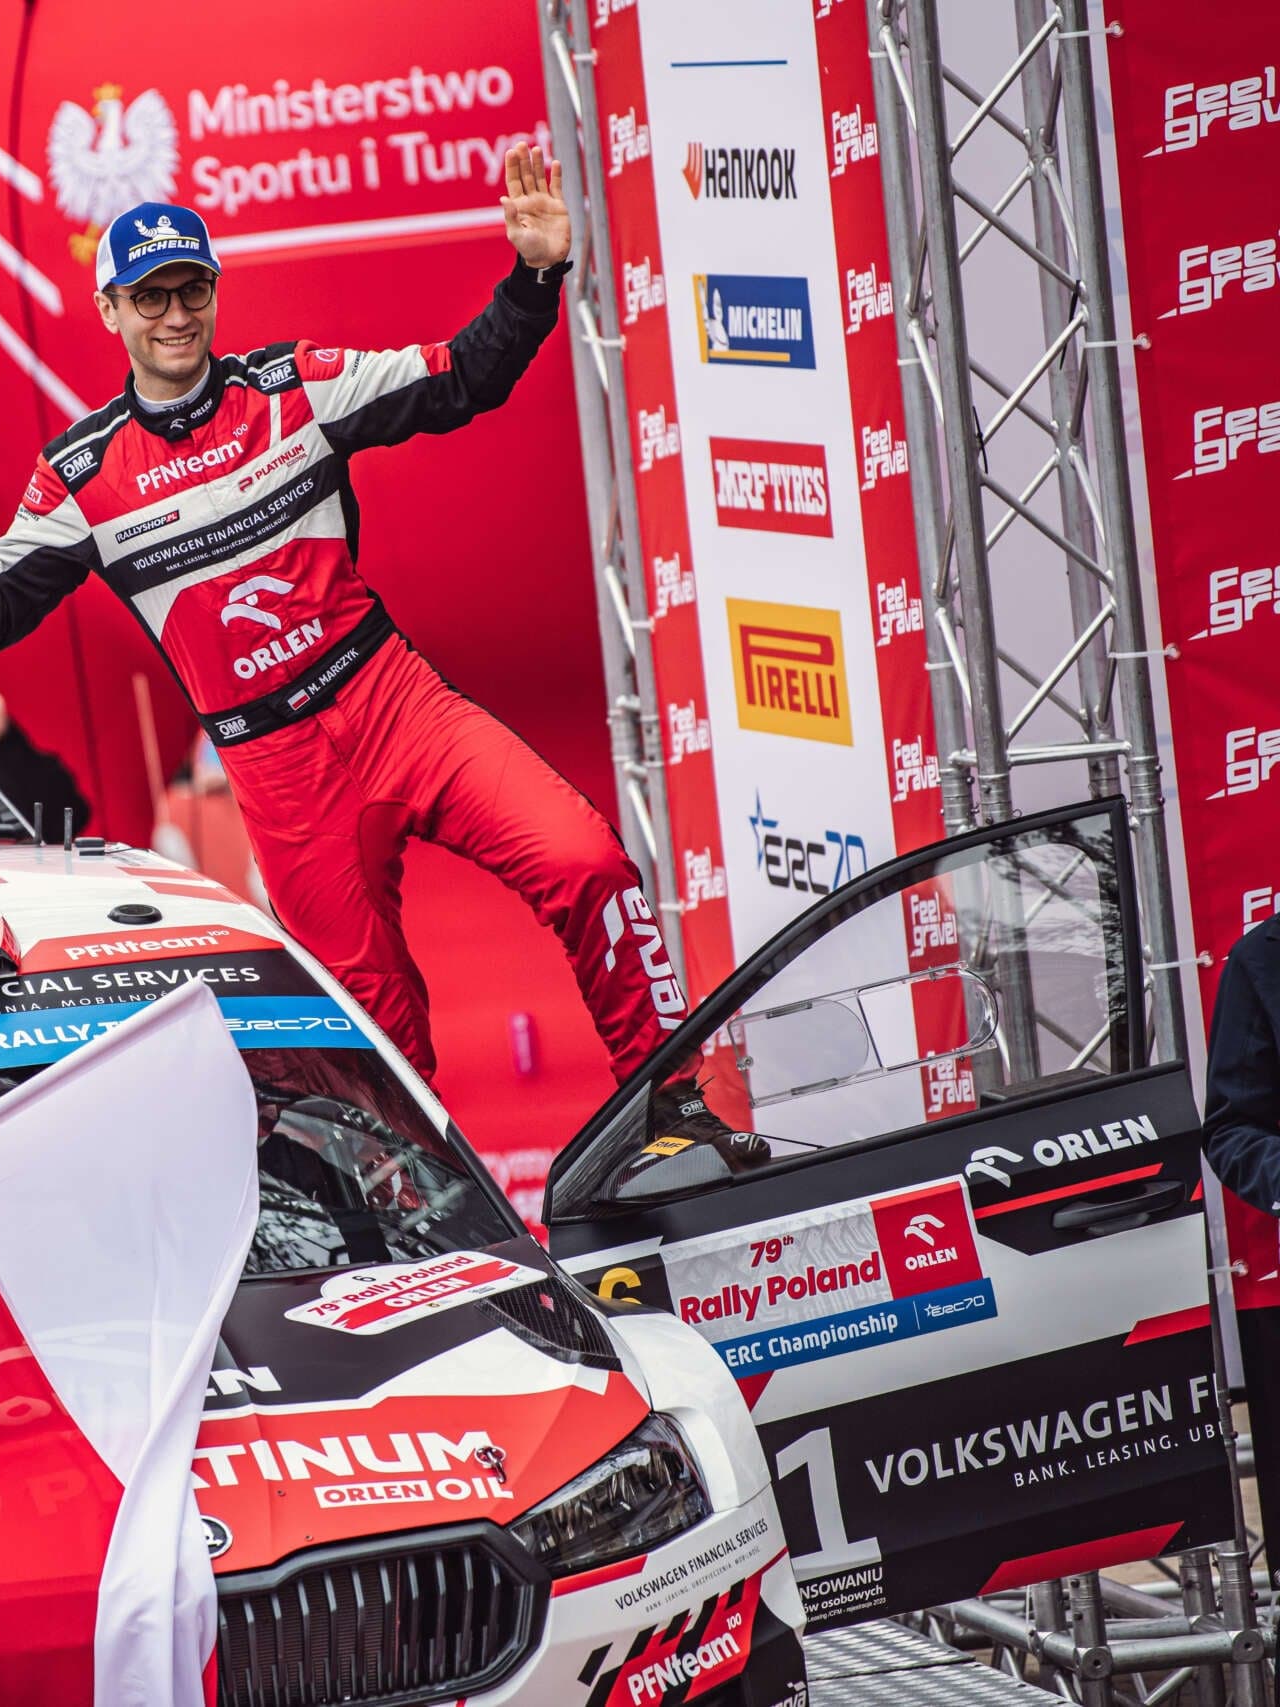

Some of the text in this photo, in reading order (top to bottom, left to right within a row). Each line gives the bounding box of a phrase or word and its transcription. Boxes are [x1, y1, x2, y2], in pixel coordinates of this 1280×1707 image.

[188, 65, 514, 141] Ministerstwo
[1164, 66, 1276, 121] Feel
[831, 104, 861, 144] Feel
[831, 123, 878, 178] gravel
[191, 137, 380, 217] Sportu i
[128, 239, 200, 263] MICHELIN
[1178, 229, 1280, 282] Fee
[847, 262, 876, 302] Feel
[727, 305, 803, 341] MICHELIN
[846, 282, 894, 335] gravel
[260, 365, 293, 388] OMP
[190, 398, 214, 421] ORLEN
[135, 438, 245, 496] PFNteam
[232, 422, 250, 438] 100
[254, 442, 306, 481] PLATINUM
[861, 421, 892, 459] Feel
[63, 450, 95, 479] OMP
[715, 458, 827, 517] MRF TYRES
[861, 440, 909, 491] gravel
[116, 510, 178, 543] RALLYSHOP.PL
[132, 477, 315, 571] VOLKSWAGEN FINANCIAL SERVICES
[876, 578, 906, 615] Feel
[876, 598, 924, 647] gravel
[232, 617, 325, 681] ORLEN
[318, 647, 360, 687] MARCZYK
[739, 623, 840, 719] PIRELLI
[219, 717, 247, 737] OMP
[892, 735, 922, 773] Feel
[892, 755, 940, 802] gravel
[909, 892, 940, 930] Feel
[910, 911, 958, 958] gravel
[64, 935, 219, 961] PFNteam
[92, 966, 262, 990] SERVICES
[681, 1101, 704, 1116] OMP
[927, 1070, 976, 1113] gravel
[1032, 1114, 1159, 1167] ORLEN
[342, 1255, 475, 1304] Rally Poland
[904, 1247, 959, 1271] ORLEN
[383, 1275, 474, 1308] ORLEN
[679, 1251, 882, 1325] Rally Poland
[725, 1294, 986, 1368] ERC Championship ERC70
[864, 1384, 1174, 1494] VOLKSWAGEN
[1013, 1458, 1077, 1488] BANK.
[1086, 1430, 1180, 1470] LEASING.
[323, 1476, 514, 1504] ORLEN OIL
[775, 1426, 882, 1581] 1
[614, 1517, 769, 1611] VOLKSWAGEN FINANCIAL SERVICES
[821, 1584, 883, 1610] osobowych
[626, 1612, 742, 1705] PFNteam 100
